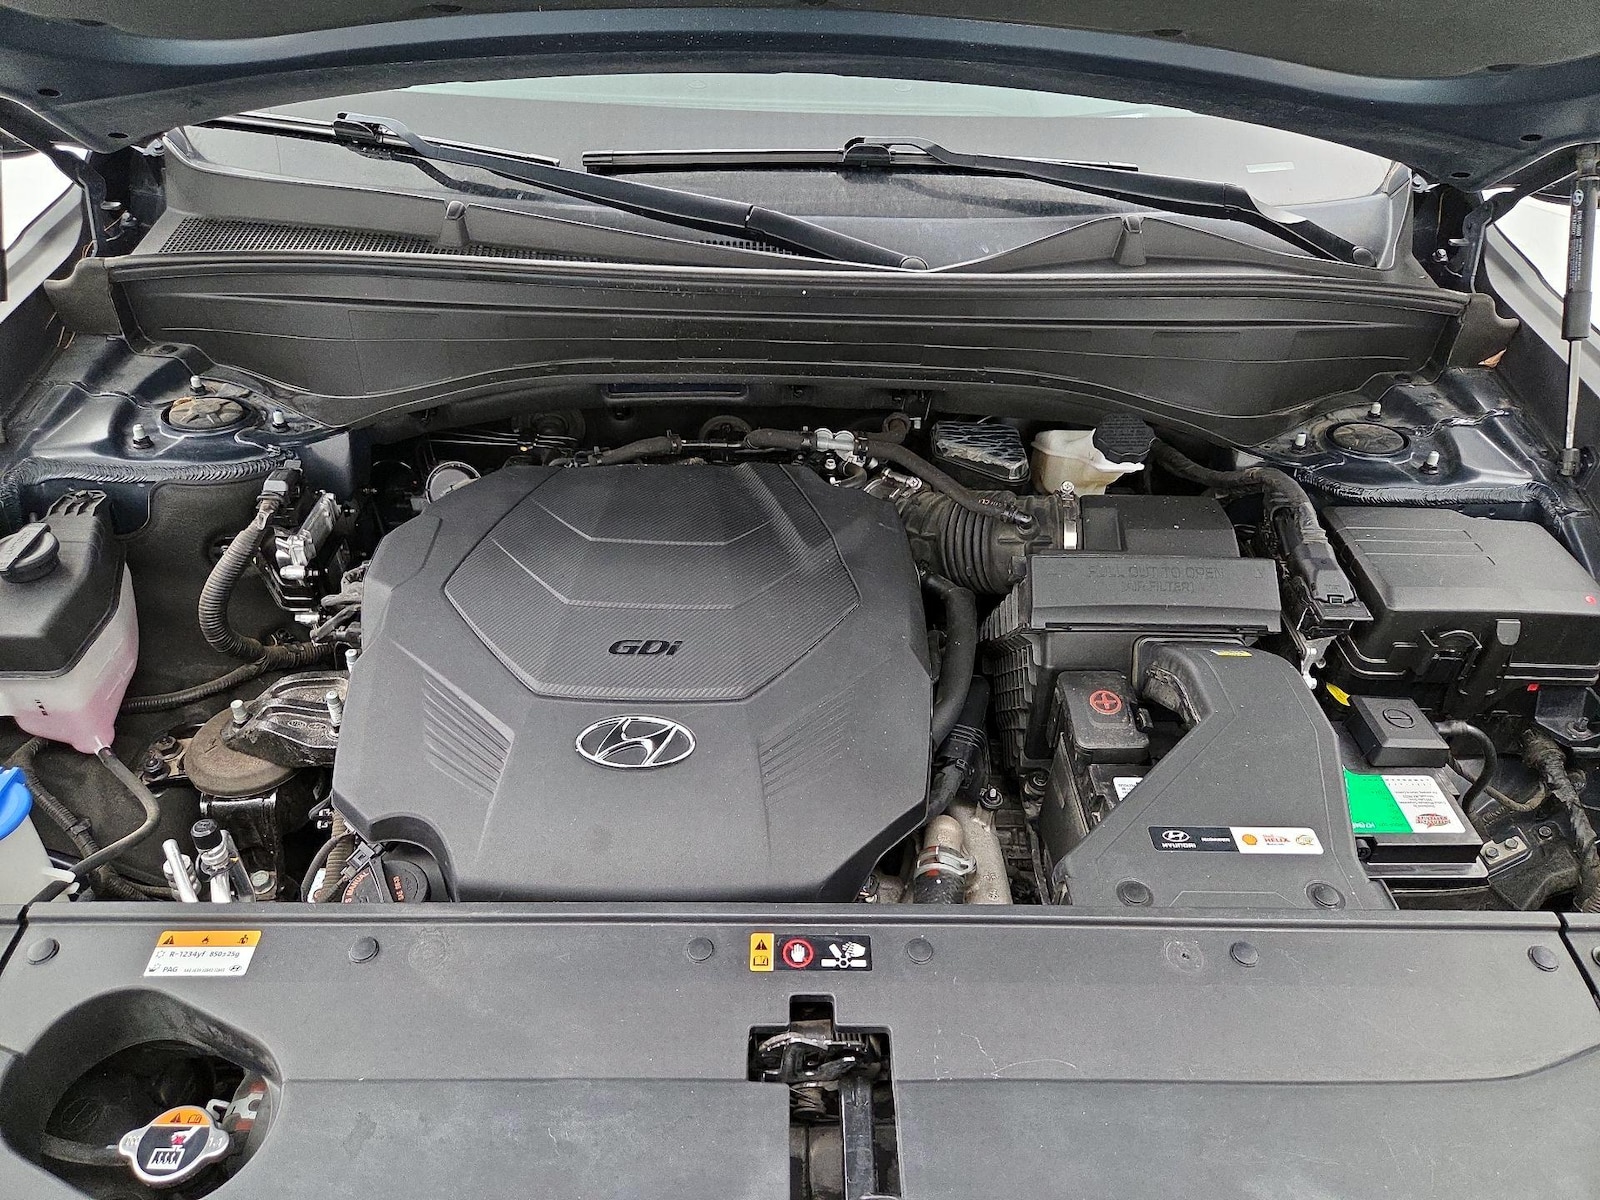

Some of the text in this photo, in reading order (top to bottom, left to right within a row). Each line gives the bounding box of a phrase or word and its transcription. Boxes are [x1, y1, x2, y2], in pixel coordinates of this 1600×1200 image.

[1088, 566, 1225, 580] PULL OUT TO OPEN
[608, 639, 683, 656] GDi
[345, 871, 370, 896] MANUAL
[169, 950, 206, 959] R-1234yf
